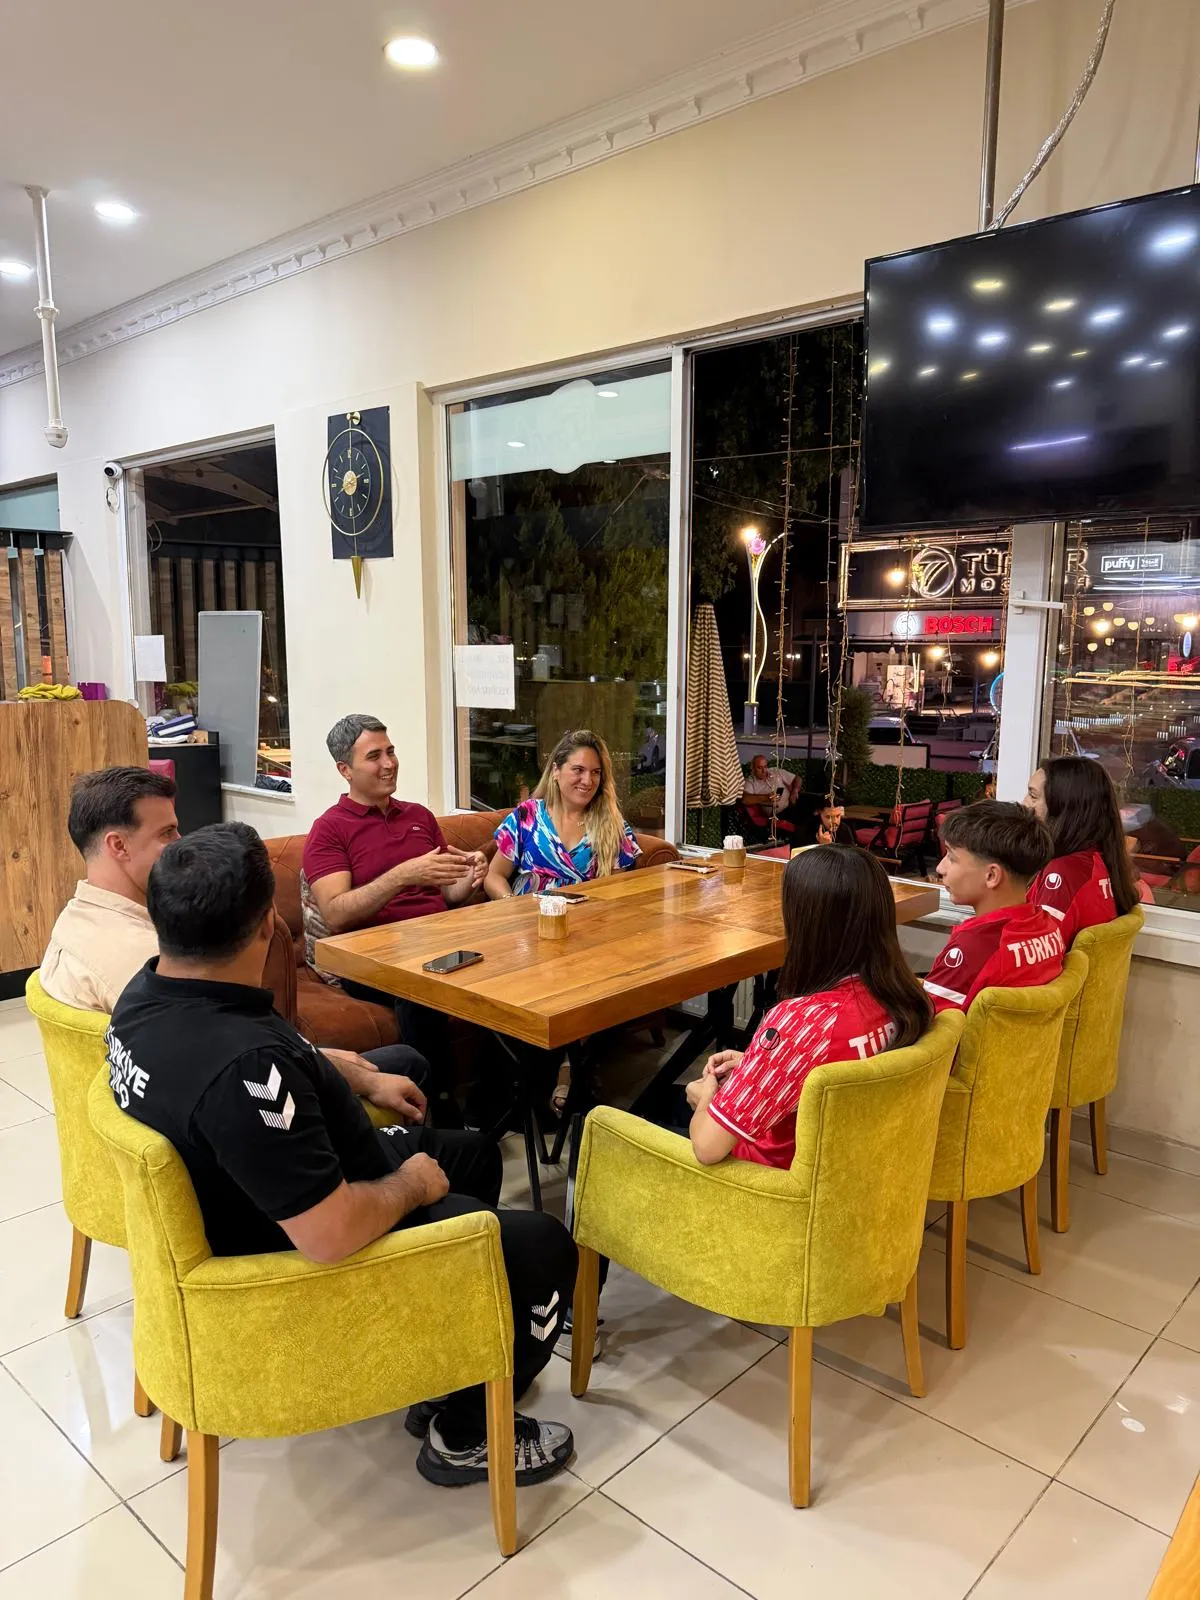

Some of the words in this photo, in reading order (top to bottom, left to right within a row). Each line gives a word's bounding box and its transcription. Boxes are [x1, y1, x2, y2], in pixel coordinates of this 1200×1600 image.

[1104, 558, 1136, 571] puffy
[923, 615, 994, 634] BOSCH
[1006, 926, 1066, 968] TÜRKİY
